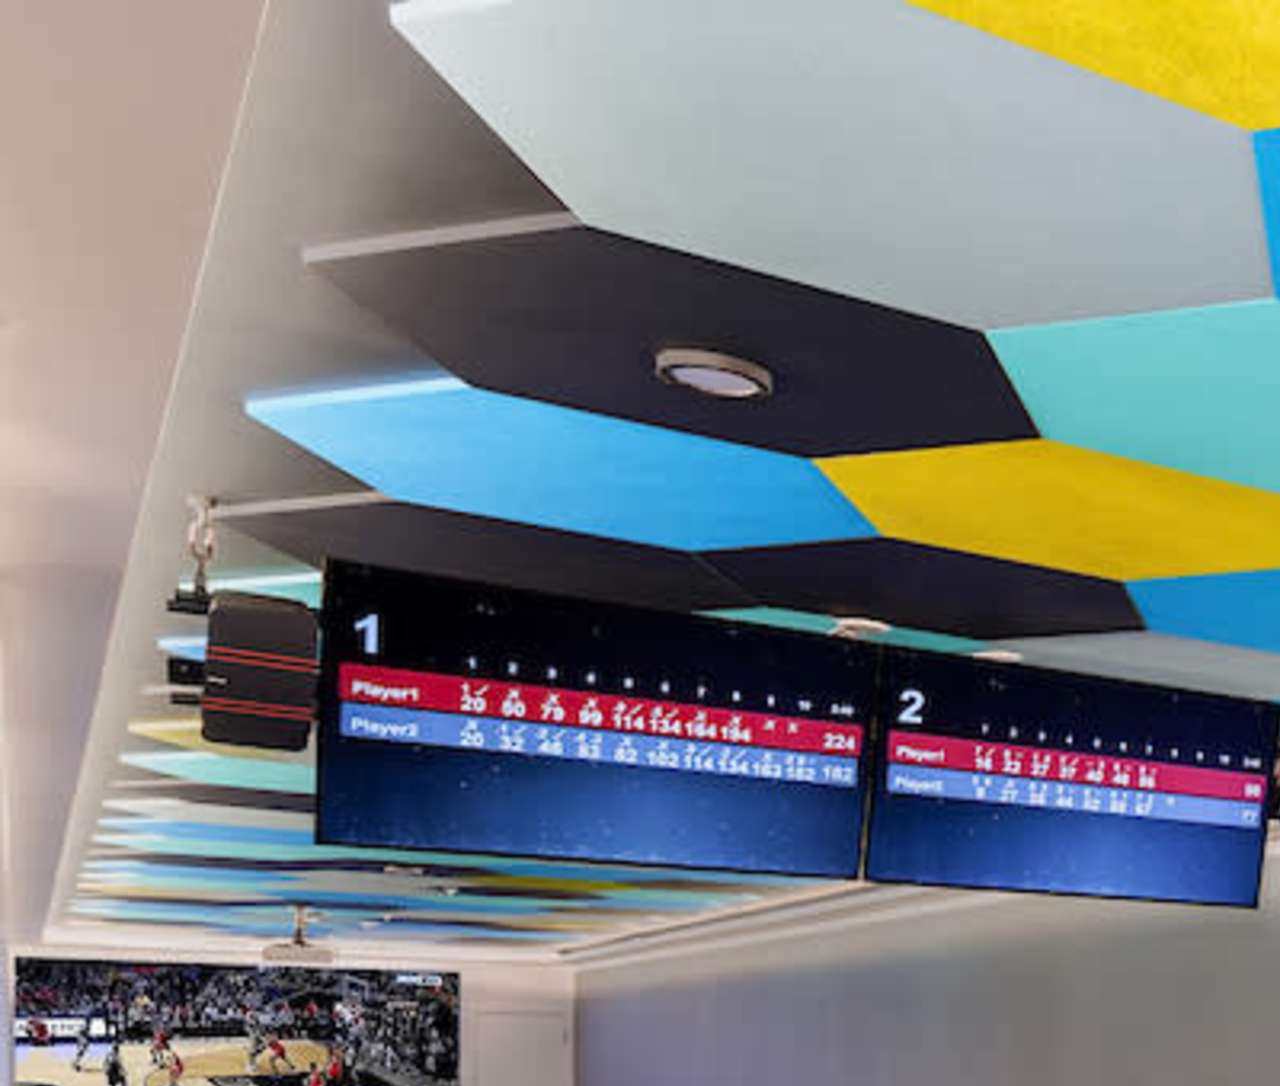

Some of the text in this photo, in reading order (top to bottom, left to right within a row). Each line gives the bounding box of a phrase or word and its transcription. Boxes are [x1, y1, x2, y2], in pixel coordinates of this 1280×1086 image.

[354, 613, 379, 654] 1
[351, 680, 419, 702] Player1
[896, 689, 926, 725] 2
[460, 694, 486, 712] 20
[823, 732, 856, 750] 224
